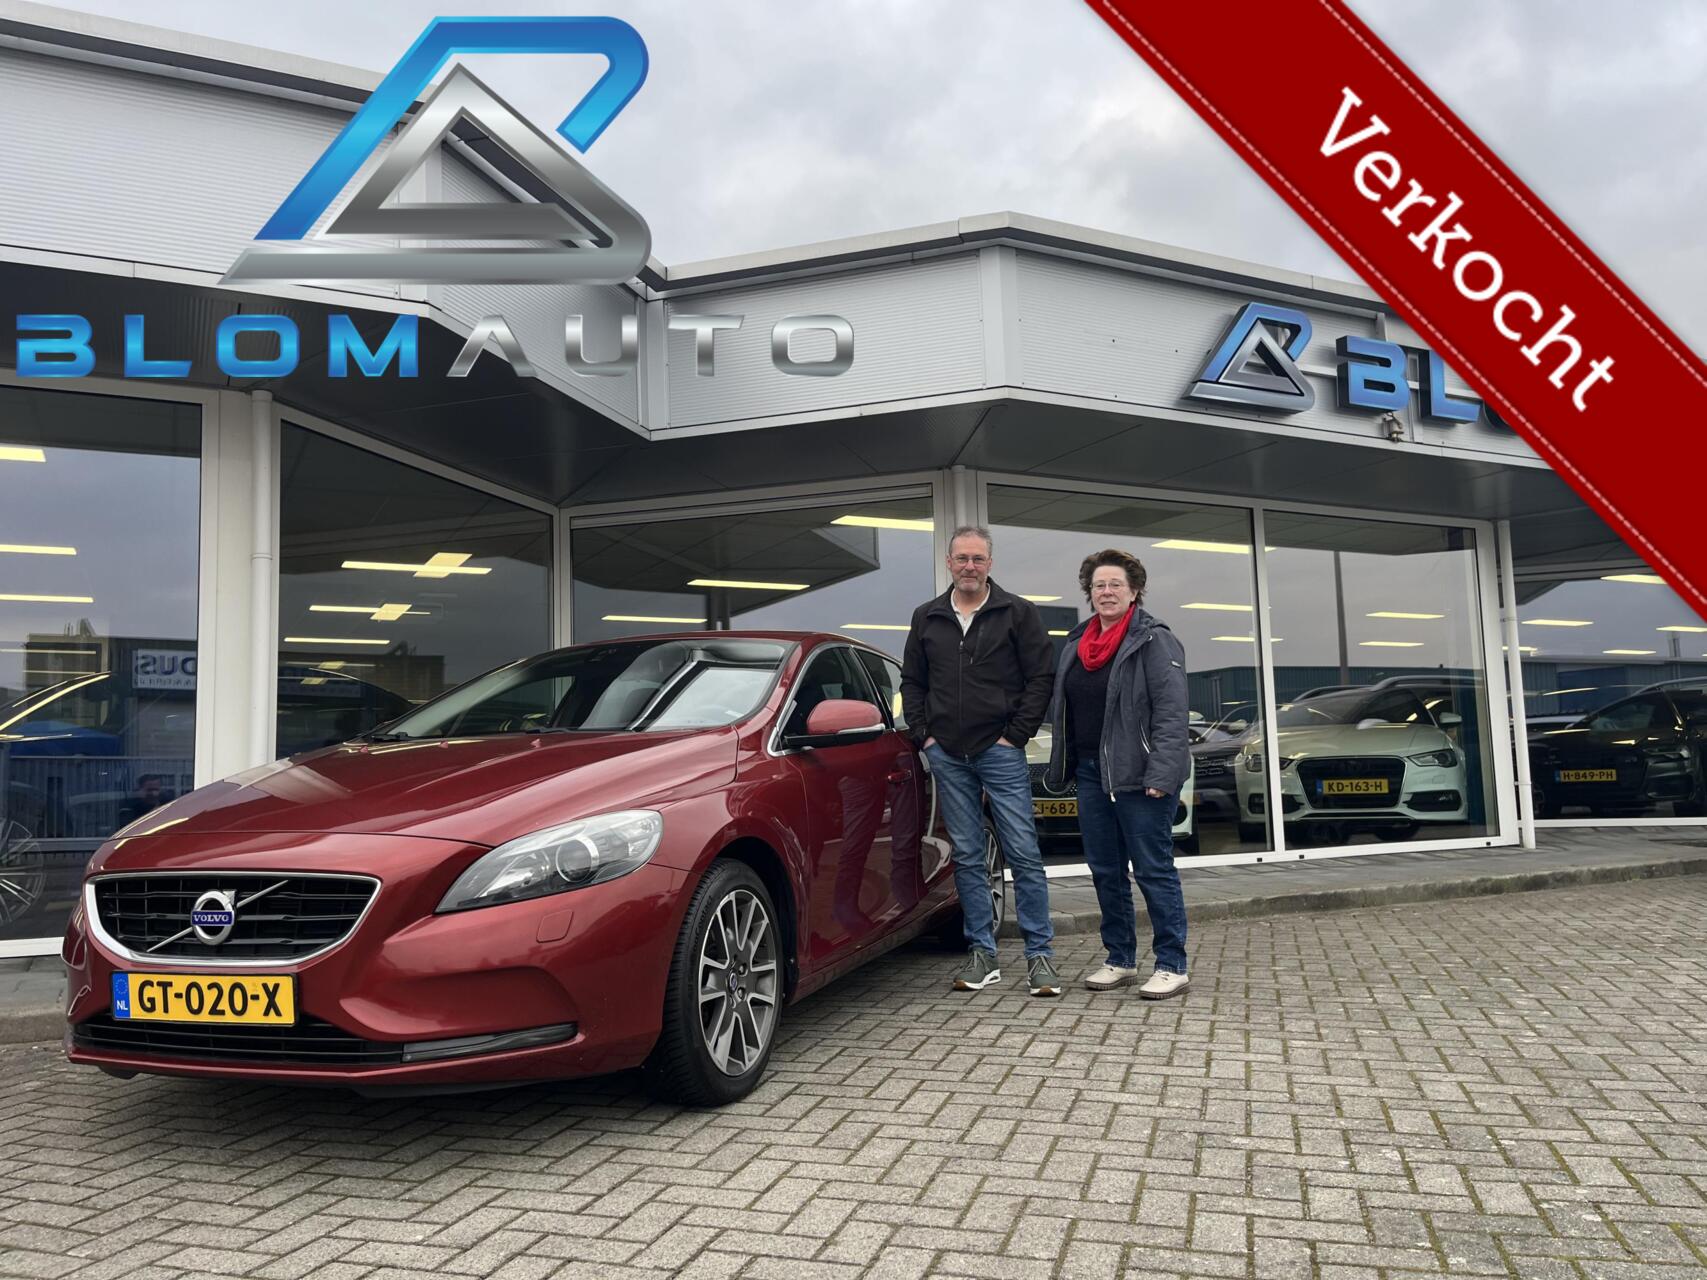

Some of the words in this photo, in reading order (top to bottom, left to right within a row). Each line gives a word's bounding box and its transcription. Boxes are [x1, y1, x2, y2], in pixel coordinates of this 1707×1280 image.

[1336, 335, 1510, 430] BL
[1562, 770, 1614, 780] H-849-PH
[1327, 781, 1383, 793] KD-163-H
[193, 914, 229, 922] VOLVO
[137, 979, 283, 1018] GT-020-X
[116, 1000, 129, 1011] NL
